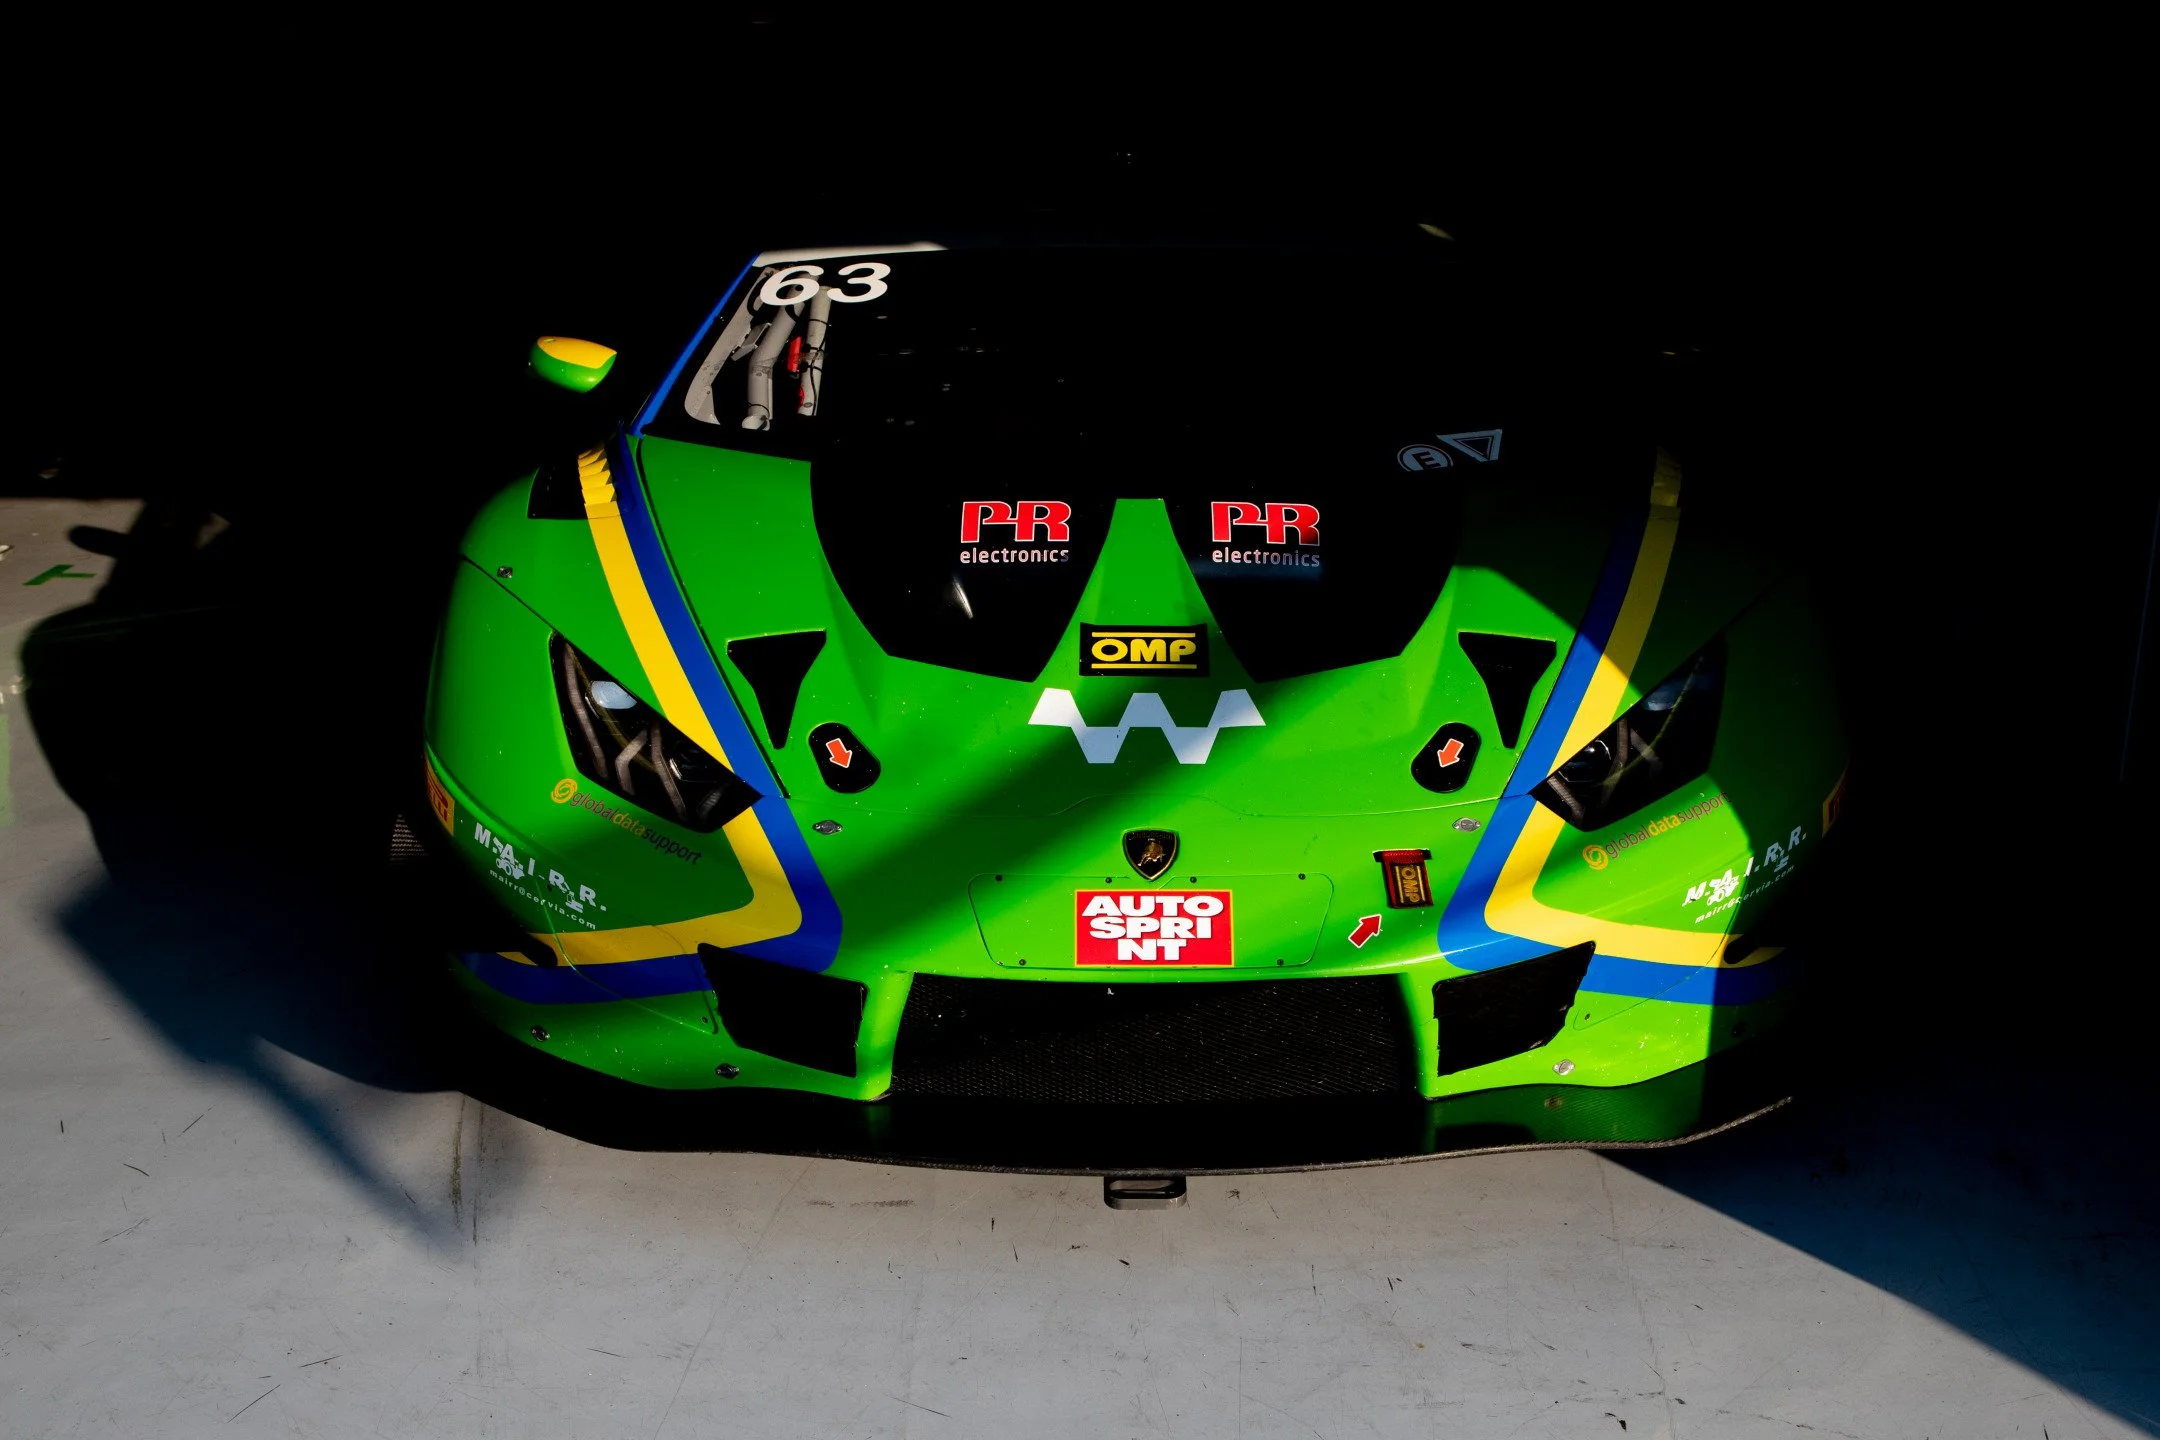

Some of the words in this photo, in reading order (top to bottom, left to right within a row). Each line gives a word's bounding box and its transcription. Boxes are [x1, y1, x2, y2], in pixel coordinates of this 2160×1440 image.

[760, 262, 891, 306] 63
[959, 547, 1070, 564] electronics
[1211, 547, 1321, 568] electronics
[1091, 638, 1198, 663] OMP
[1401, 866, 1420, 903] OMP
[1081, 895, 1224, 917] AUTO
[1089, 916, 1212, 939] SPRI
[1117, 939, 1187, 961] NT
